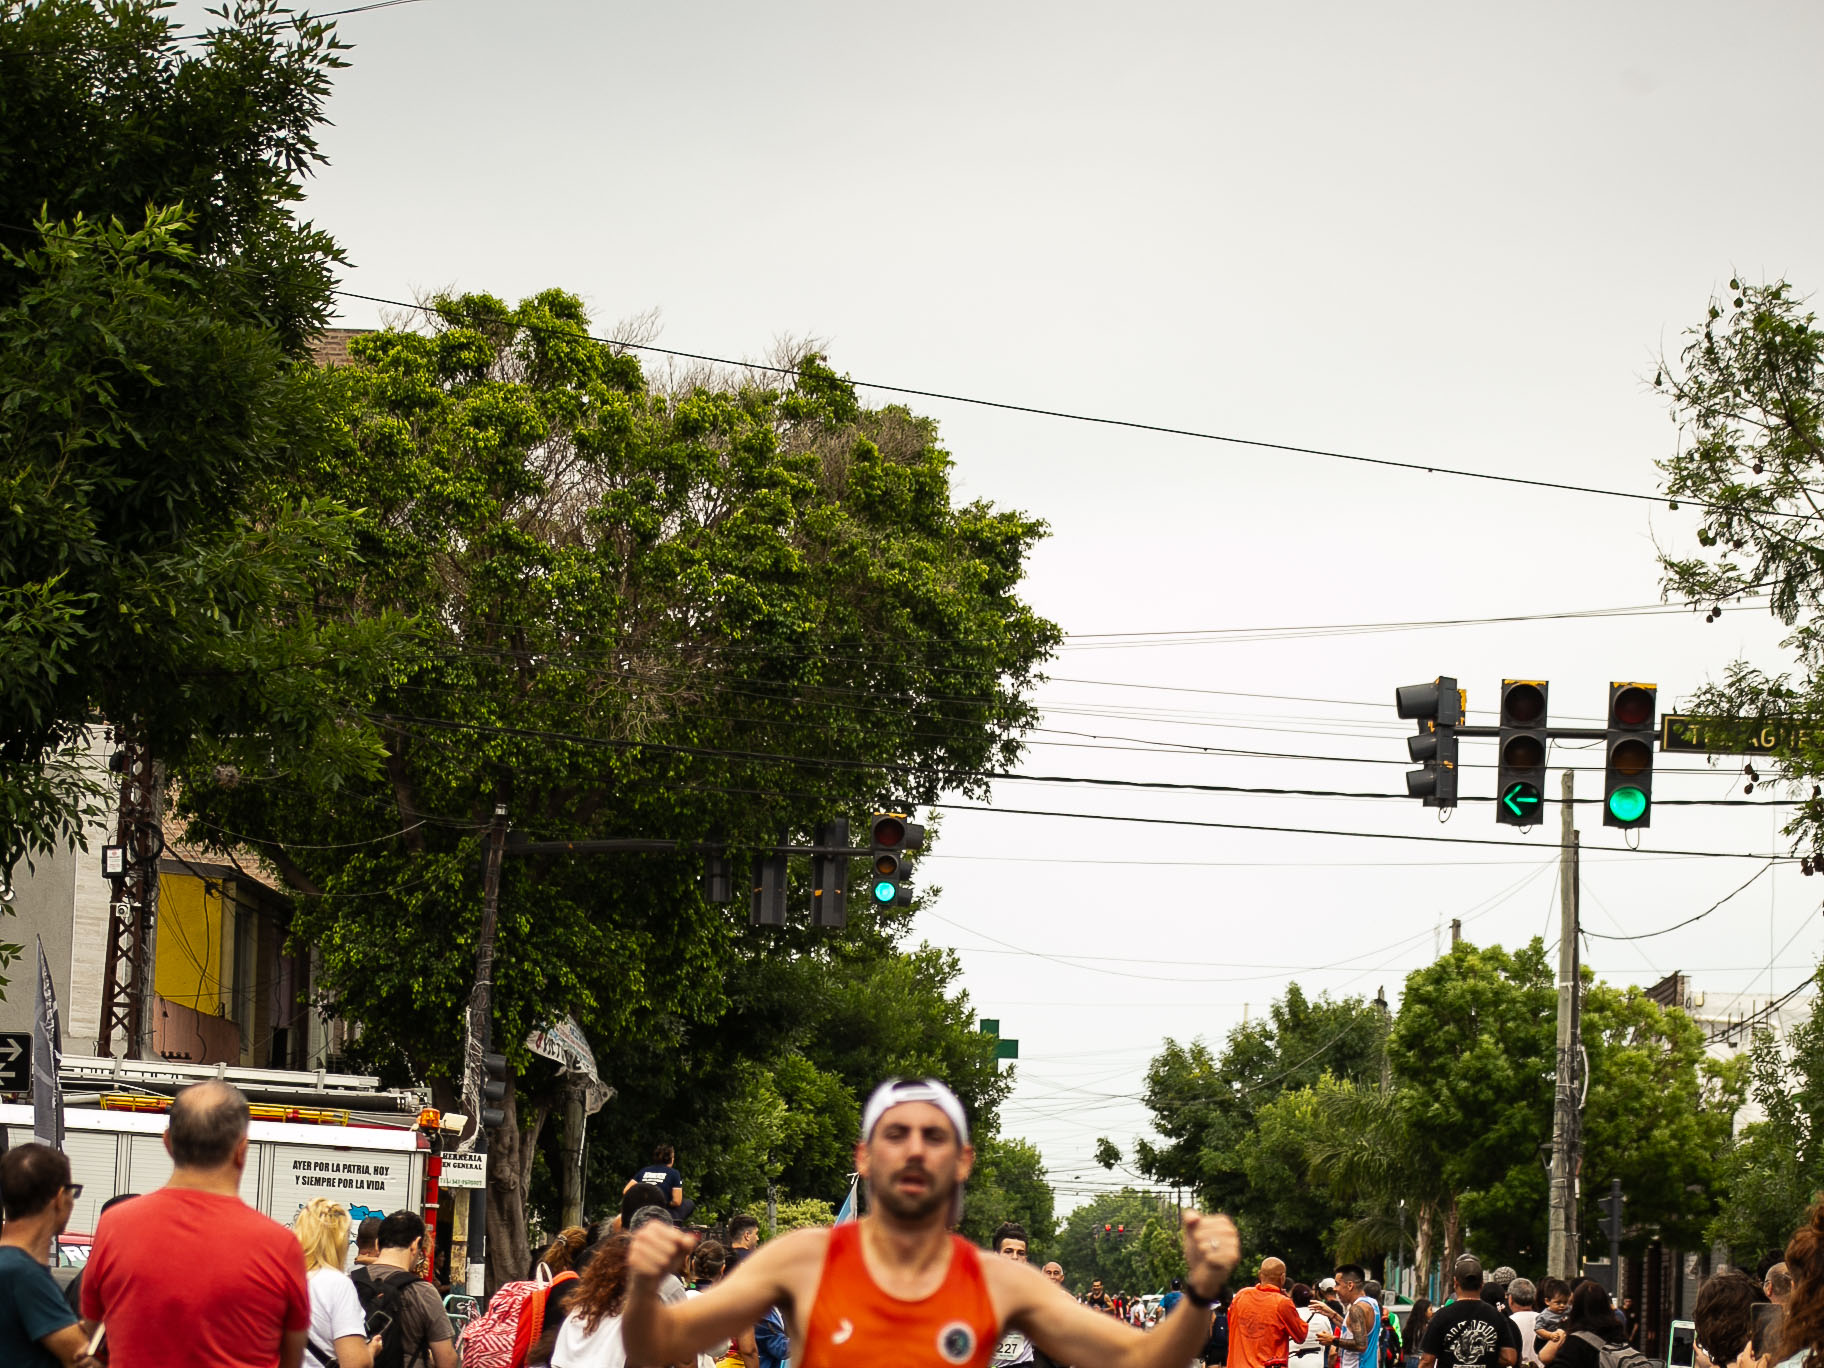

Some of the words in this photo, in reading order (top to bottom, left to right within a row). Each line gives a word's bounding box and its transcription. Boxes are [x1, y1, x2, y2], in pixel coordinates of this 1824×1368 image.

[292, 1160, 312, 1170] AYER
[314, 1162, 330, 1172] POR
[332, 1163, 340, 1172] LA
[342, 1164, 372, 1175] PATRIA,
[374, 1166, 390, 1176] HOY
[296, 1175, 300, 1185] Y
[302, 1176, 336, 1187] SIEMPRE
[338, 1178, 354, 1188] POR
[356, 1179, 364, 1189] LA
[366, 1180, 386, 1190] VIDA
[996, 1344, 1018, 1354] 227
